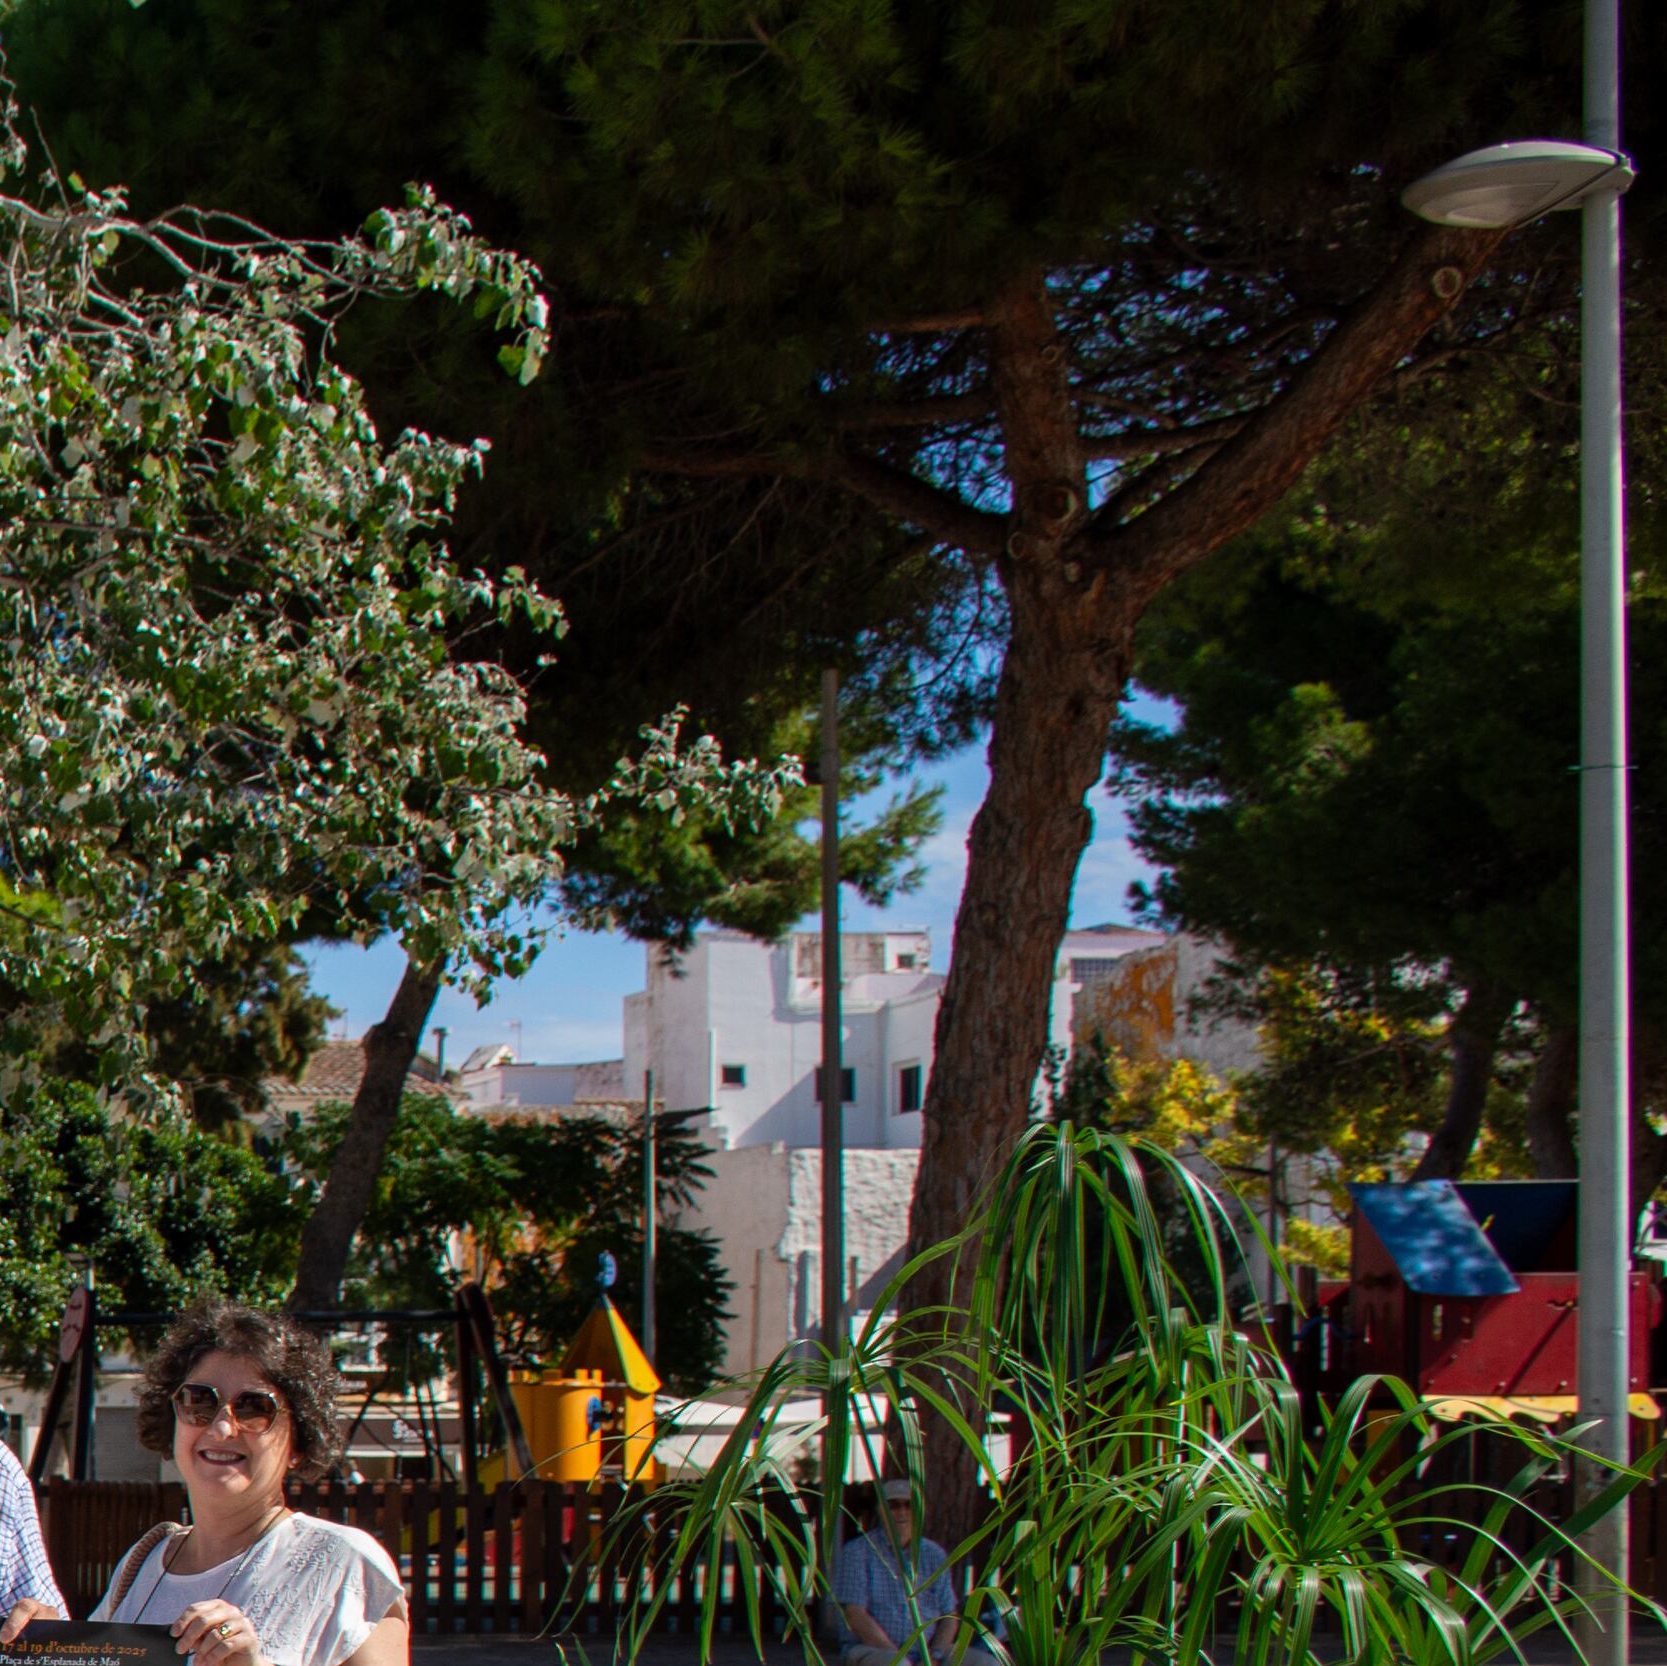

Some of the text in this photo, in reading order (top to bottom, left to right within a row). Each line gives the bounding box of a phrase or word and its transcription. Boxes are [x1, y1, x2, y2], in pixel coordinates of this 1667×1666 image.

[16, 1640, 27, 1652] al
[30, 1643, 43, 1653] 19
[103, 1643, 115, 1654] de
[118, 1647, 147, 1656] 2025
[0, 1655, 22, 1666] Plaça
[24, 1657, 34, 1665] de
[87, 1657, 97, 1666] de
[99, 1657, 120, 1666] Maó
